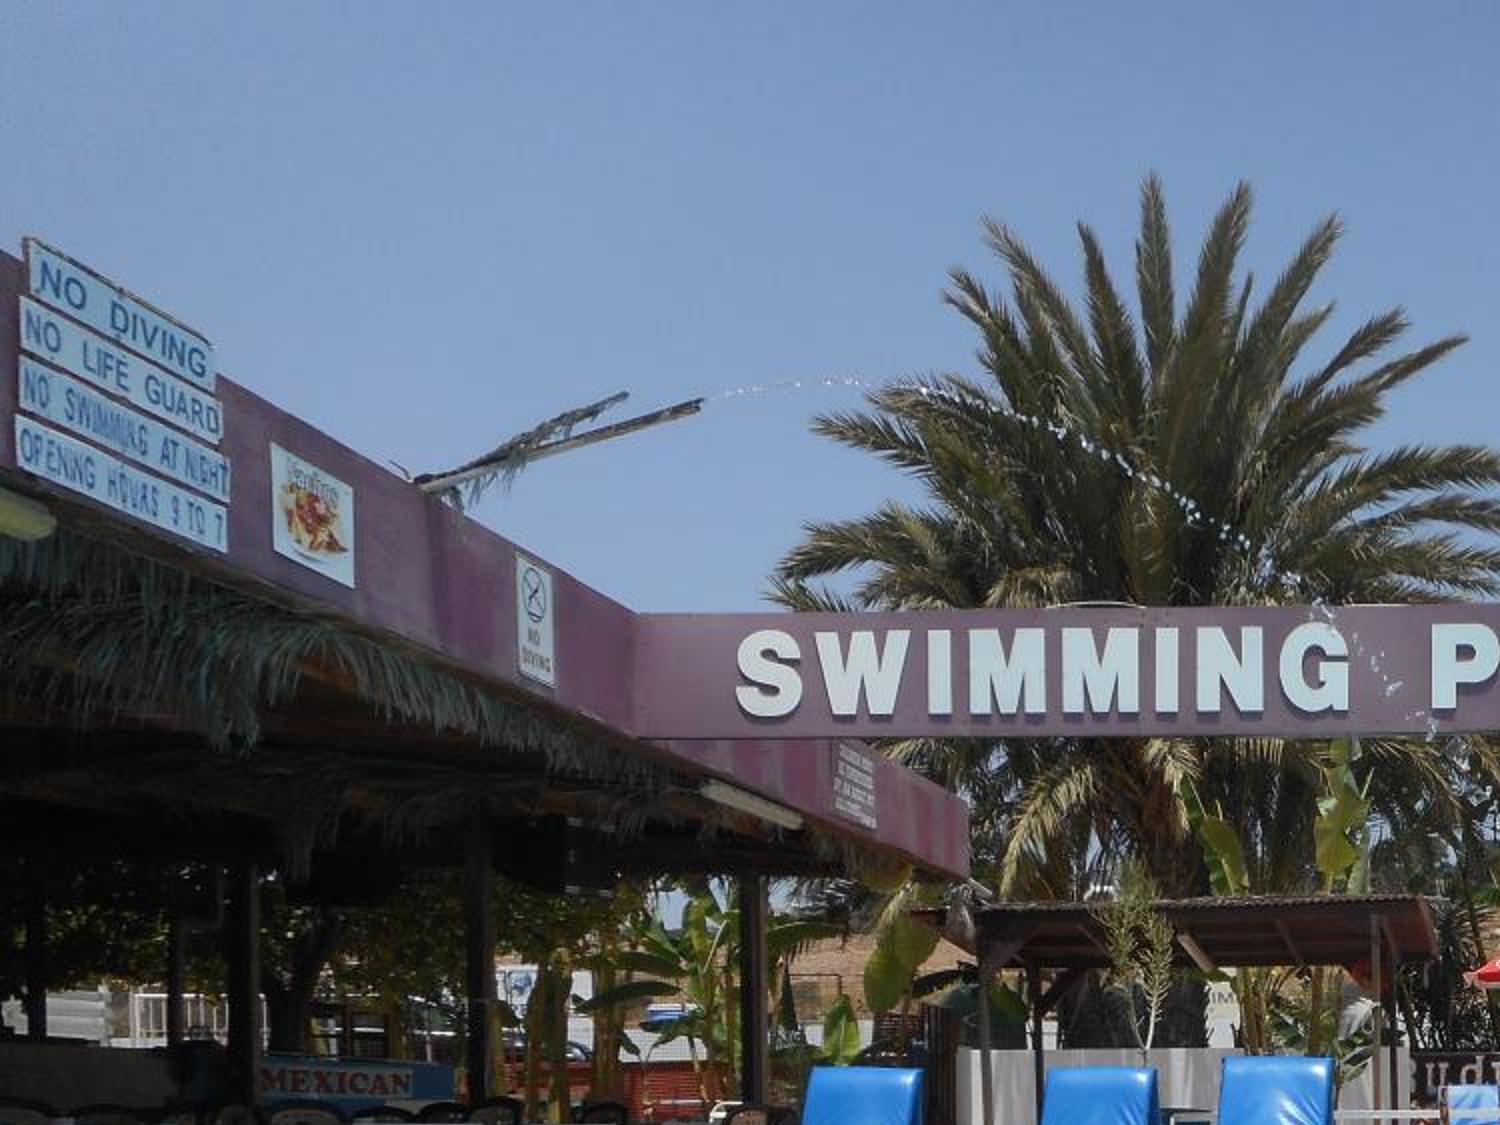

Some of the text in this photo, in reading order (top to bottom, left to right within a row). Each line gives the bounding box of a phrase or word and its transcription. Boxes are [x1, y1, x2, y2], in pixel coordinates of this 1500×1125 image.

[25, 308, 219, 434] NO LIFE GUARD
[40, 259, 207, 378] NO DIVING
[20, 428, 224, 546] OPENING HOURS 9 TO 7
[24, 367, 228, 497] NO SWIMMING AT NIGHT
[735, 621, 1350, 719] SWIMMING
[261, 1067, 413, 1094] MEXICAN
